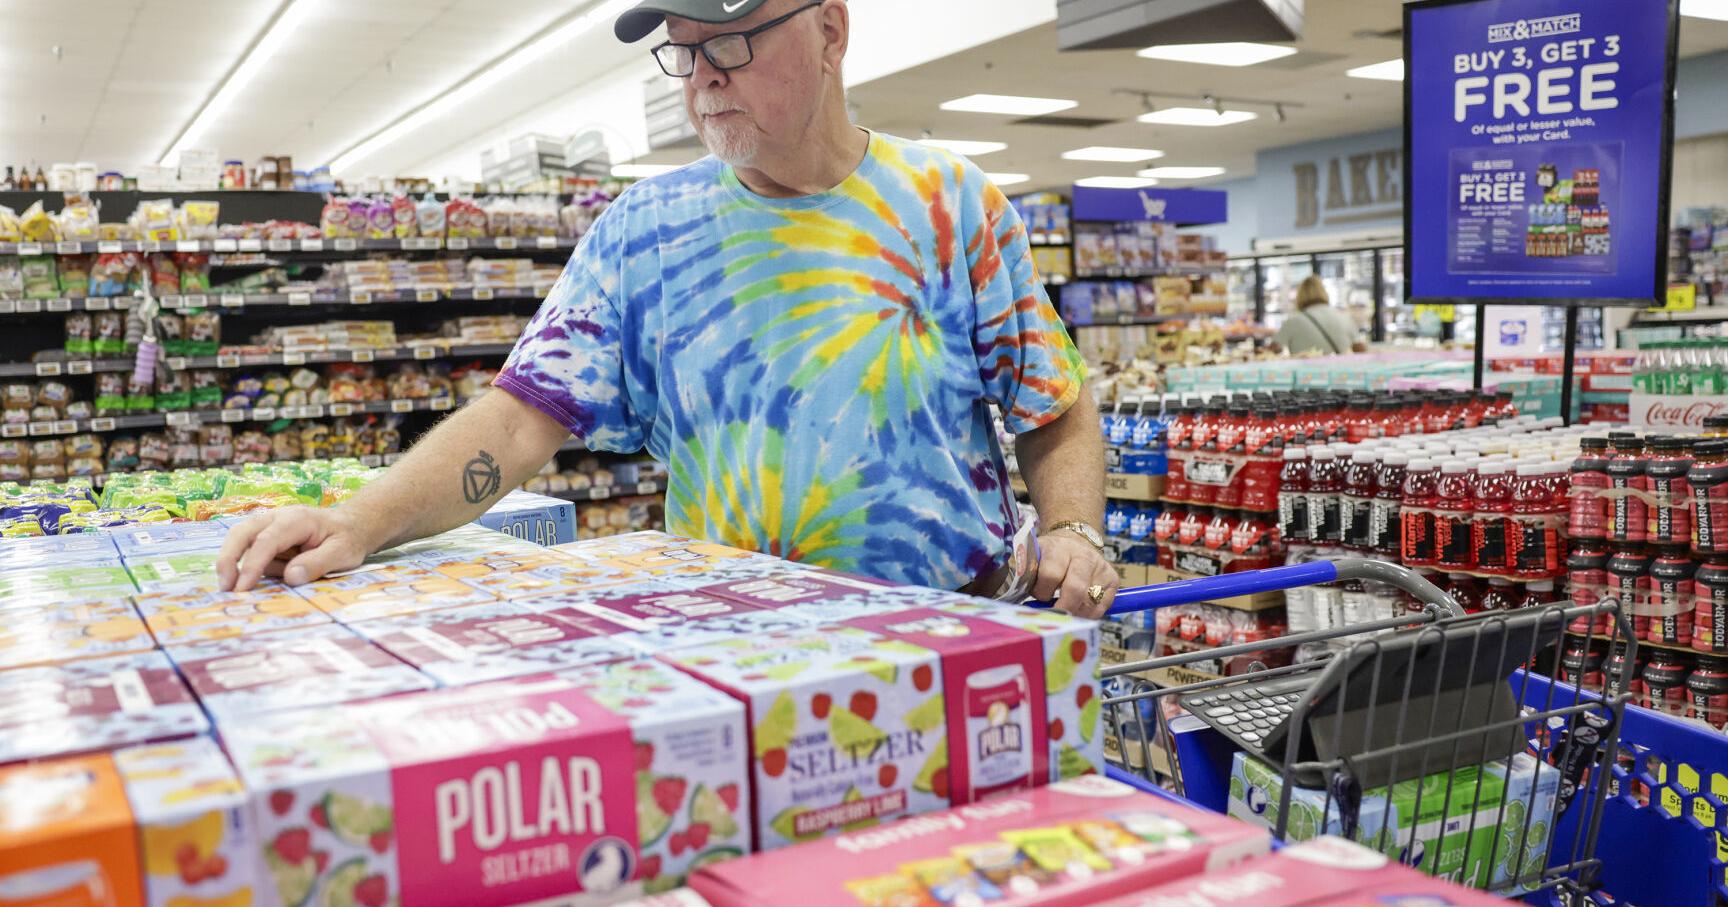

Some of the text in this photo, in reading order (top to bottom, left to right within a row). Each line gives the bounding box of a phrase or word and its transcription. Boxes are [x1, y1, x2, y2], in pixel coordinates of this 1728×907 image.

[1454, 35, 1620, 74] BUY 3, GET 3
[1454, 61, 1620, 123] FREE
[1471, 124, 1485, 135] Of
[1486, 123, 1515, 135] equal
[1516, 121, 1528, 132] or
[1530, 119, 1561, 131] lesser
[1492, 133, 1516, 144] with
[1517, 132, 1541, 144] your
[1459, 173, 1481, 184] BUY
[1495, 171, 1517, 182] GET
[1518, 171, 1526, 181] 3
[1459, 182, 1525, 203] FREE
[560, 506, 565, 518] 8
[501, 519, 557, 547] POLAR
[790, 728, 924, 783] SELTZER
[979, 723, 1021, 760] POLAR
[435, 756, 605, 864] POLAR
[796, 799, 872, 836] RASPBERRY
[480, 842, 570, 887] SELTZER
